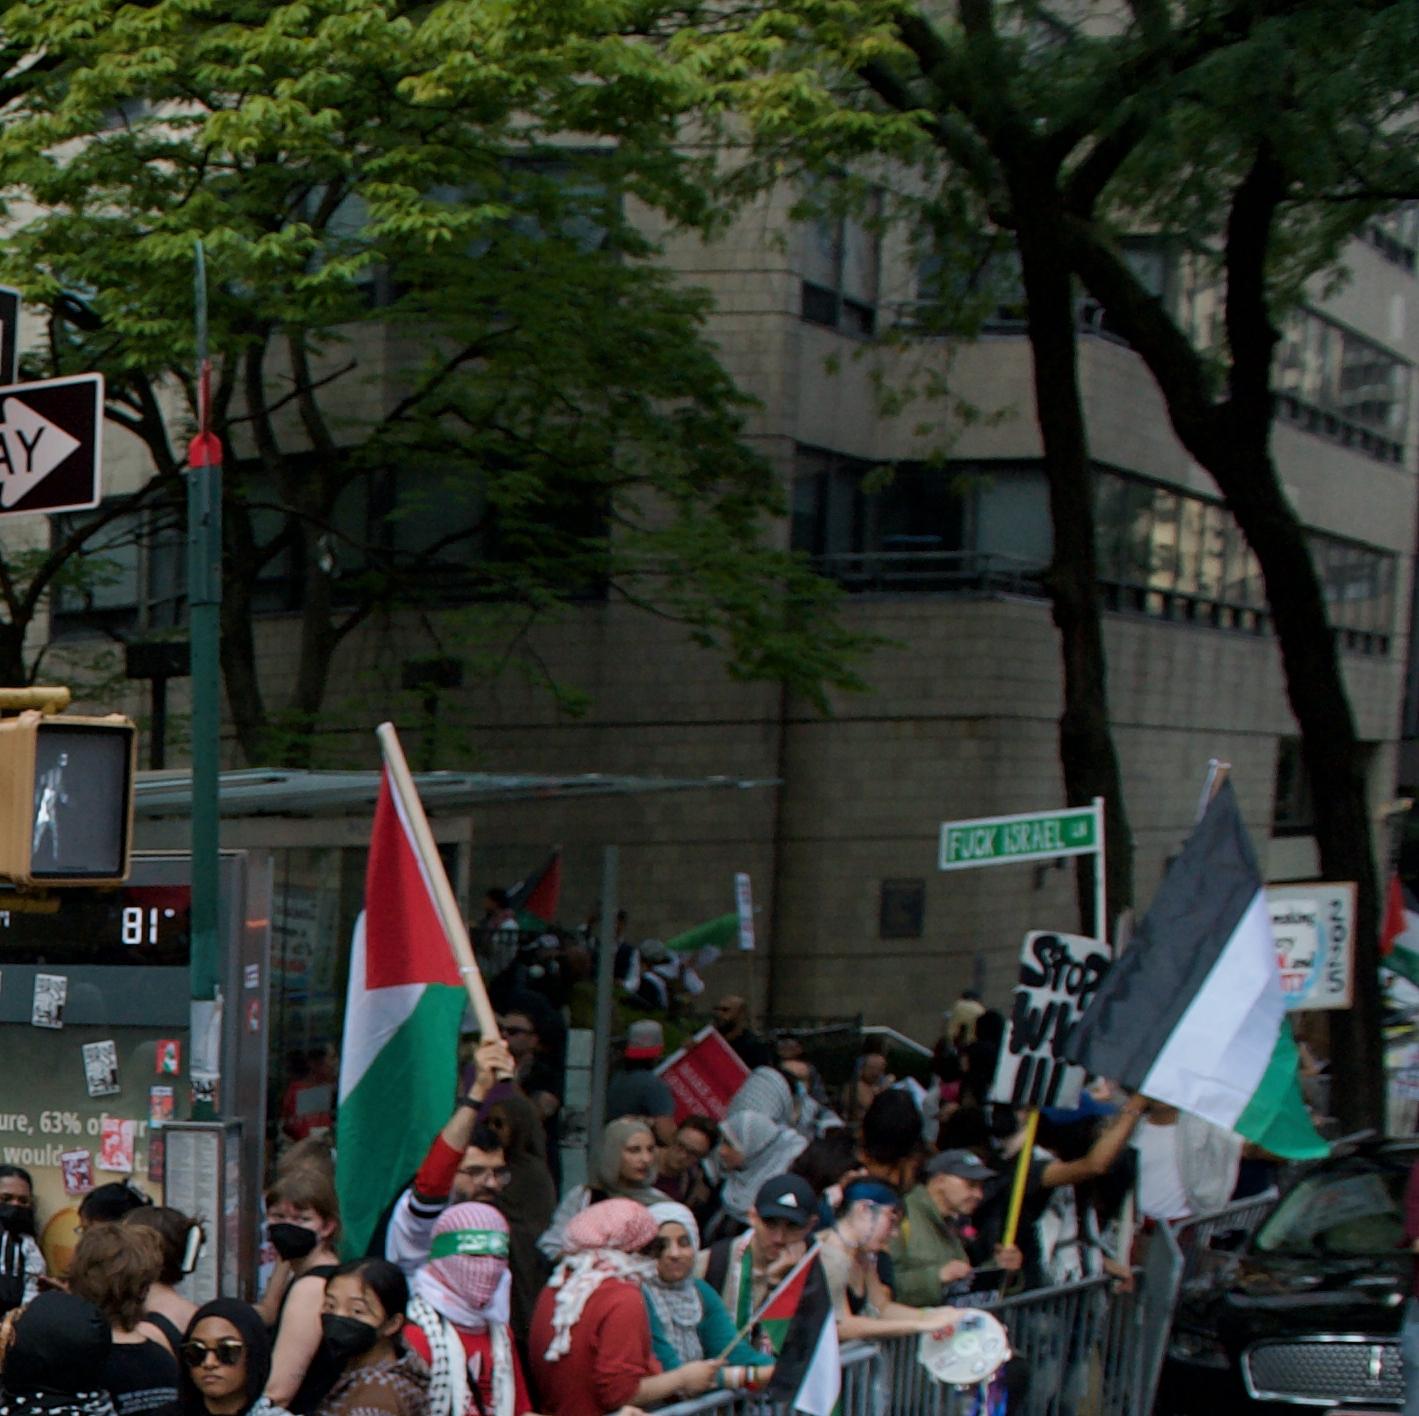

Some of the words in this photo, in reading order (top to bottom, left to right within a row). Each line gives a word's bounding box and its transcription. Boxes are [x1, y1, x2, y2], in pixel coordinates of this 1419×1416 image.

[949, 827, 997, 861] FUCK
[1003, 819, 1065, 854] ISRAEL
[39, 1110, 82, 1135] 63%
[4, 1143, 63, 1166] would
